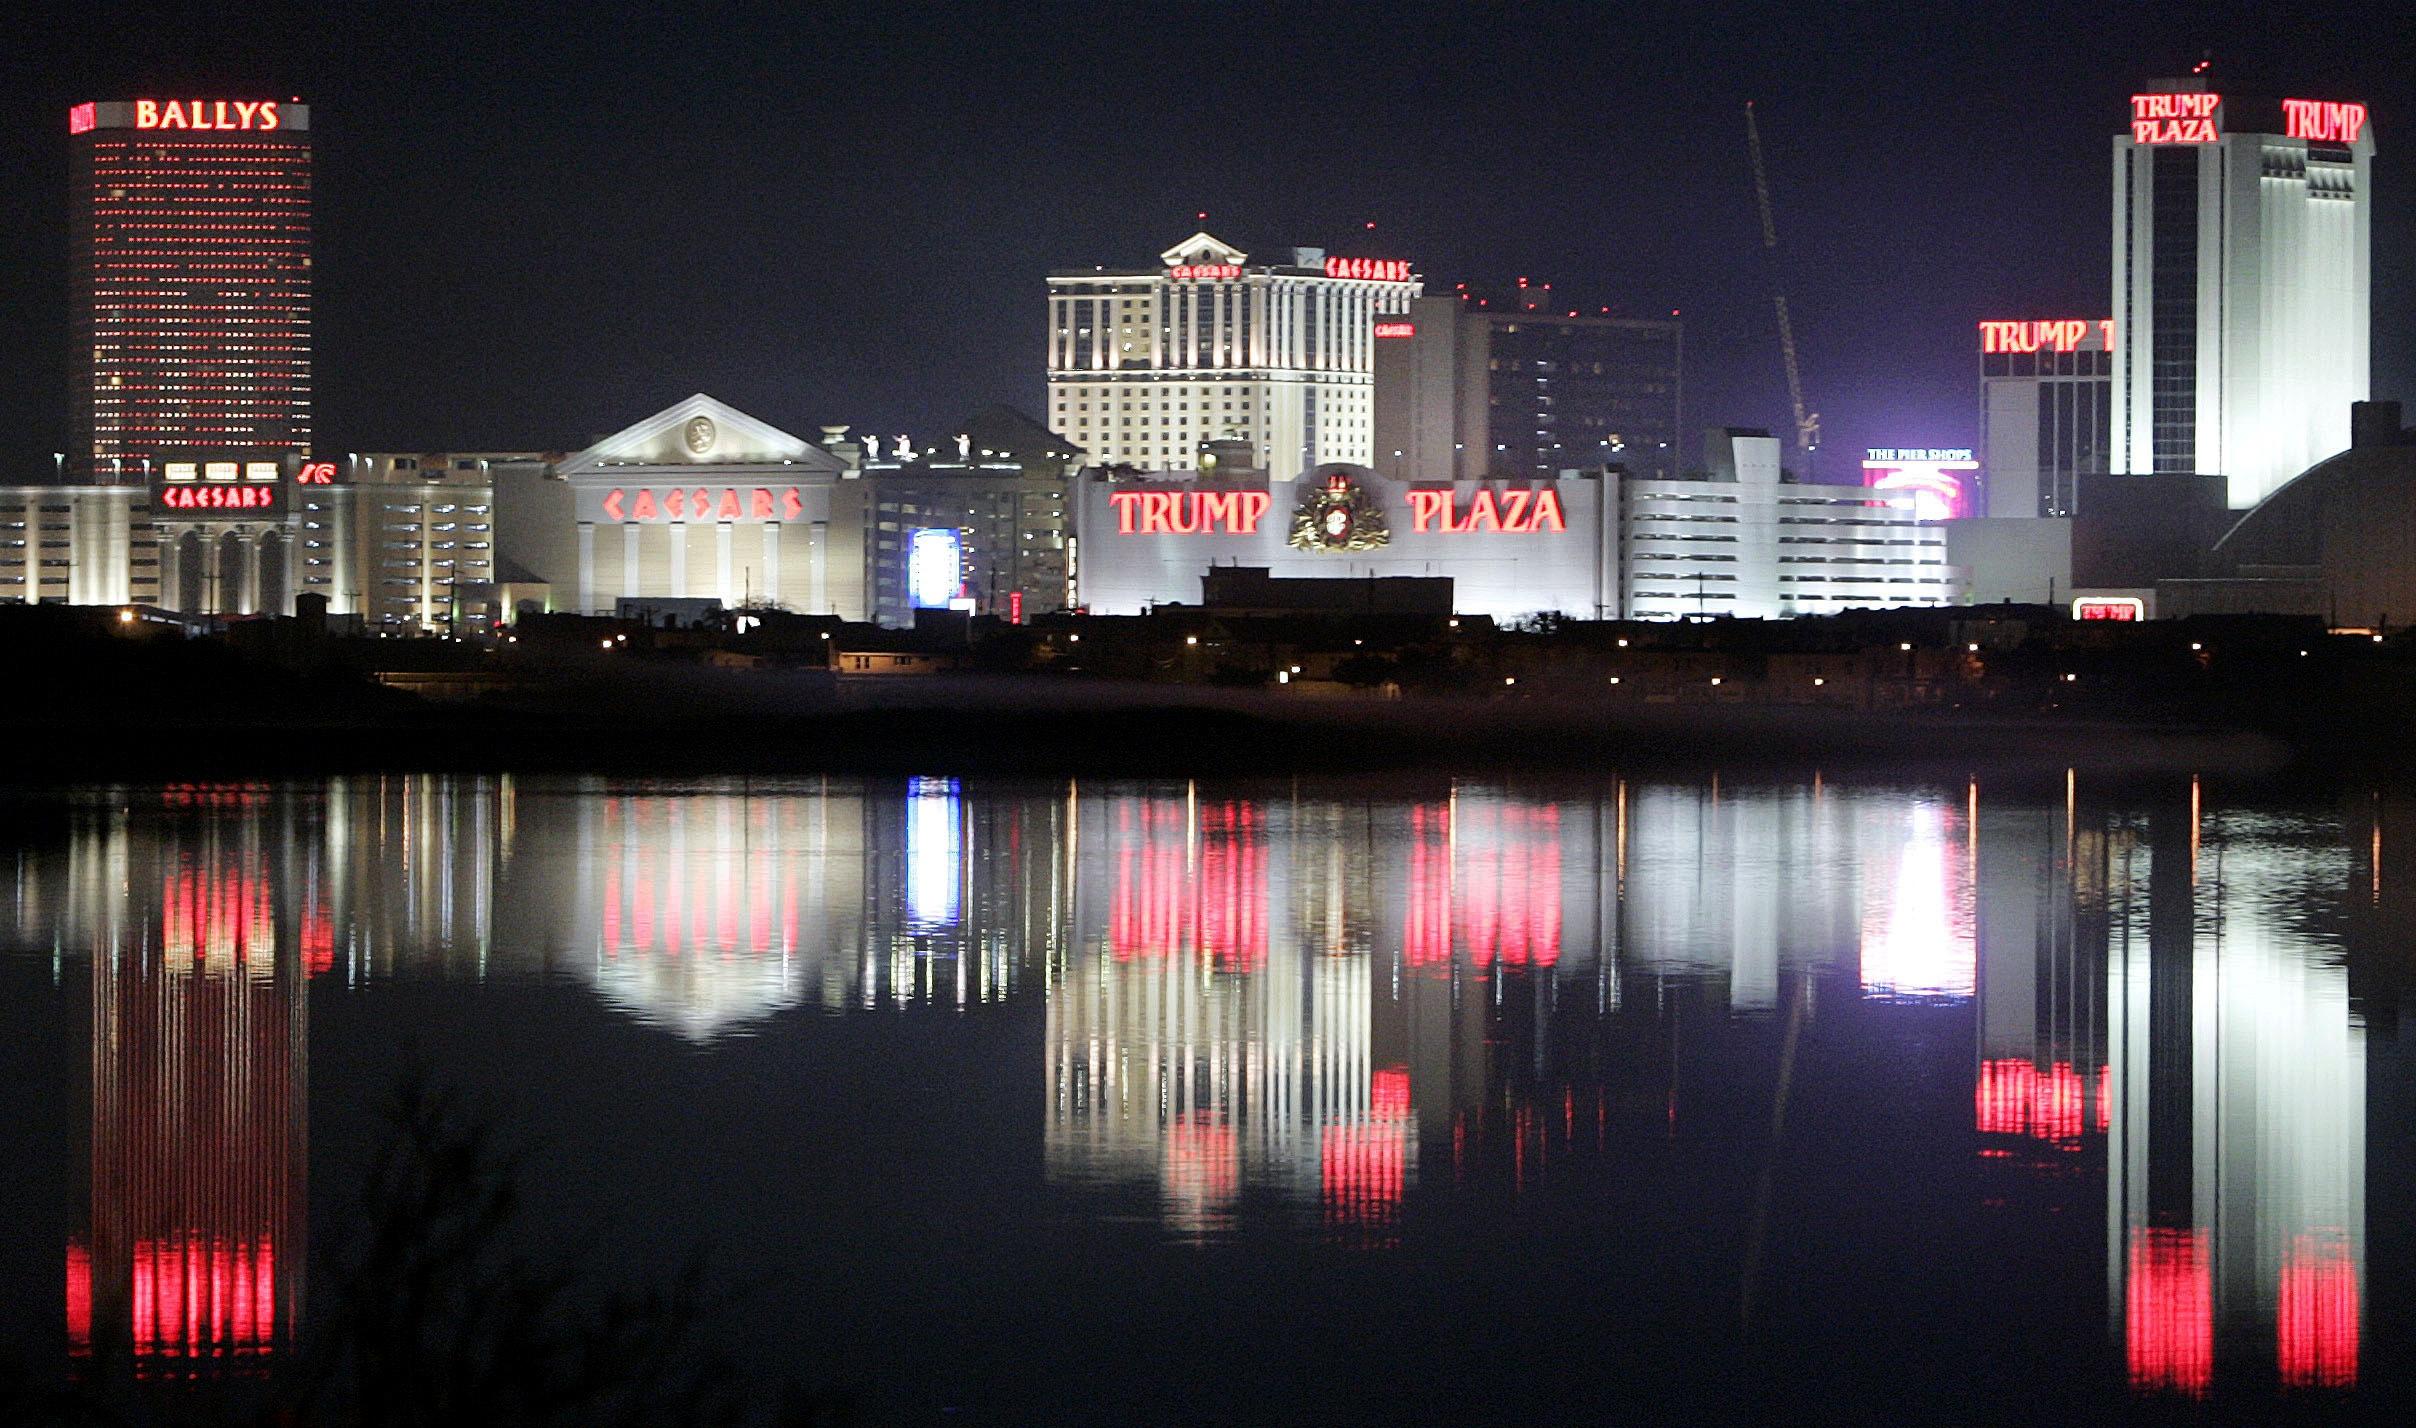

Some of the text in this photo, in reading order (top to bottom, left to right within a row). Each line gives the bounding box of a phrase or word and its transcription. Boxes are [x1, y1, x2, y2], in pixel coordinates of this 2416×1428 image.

[136, 99, 280, 130] BALLYS
[2131, 94, 2221, 118] TRUMP
[2131, 119, 2219, 144] PLAZA
[2282, 98, 2367, 143] TRUMP
[1325, 256, 1410, 282] CAESARS
[1978, 320, 2089, 353] TRUMP
[1867, 448, 1896, 460] THE
[163, 486, 272, 508] CAESARS
[603, 487, 803, 520] CAESARS
[1109, 488, 1568, 535] TRUMP PLAZA
